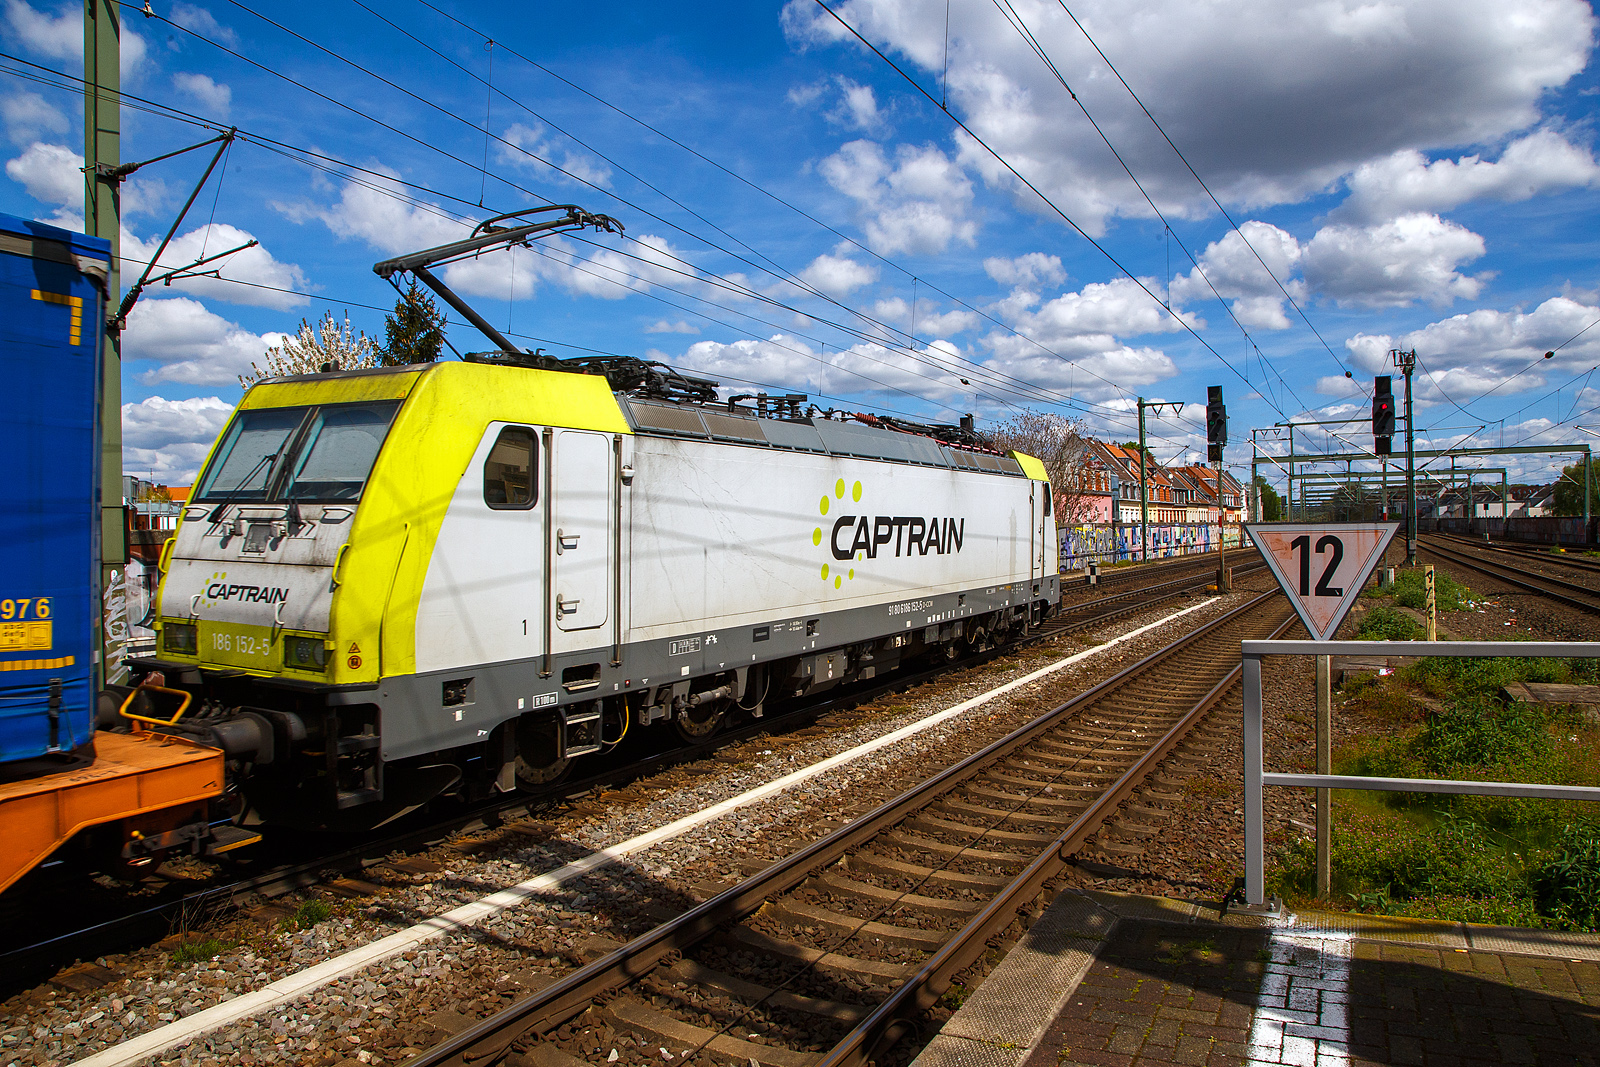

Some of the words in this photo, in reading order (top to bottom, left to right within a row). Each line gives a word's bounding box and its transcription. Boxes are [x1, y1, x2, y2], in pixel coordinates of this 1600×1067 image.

[831, 515, 965, 561] CAPTRAIN
[1290, 535, 1344, 597] 12
[206, 583, 289, 604] CAPTRAIN
[522, 619, 526, 635] 1
[212, 632, 232, 651] 186
[235, 635, 270, 656] 152-5
